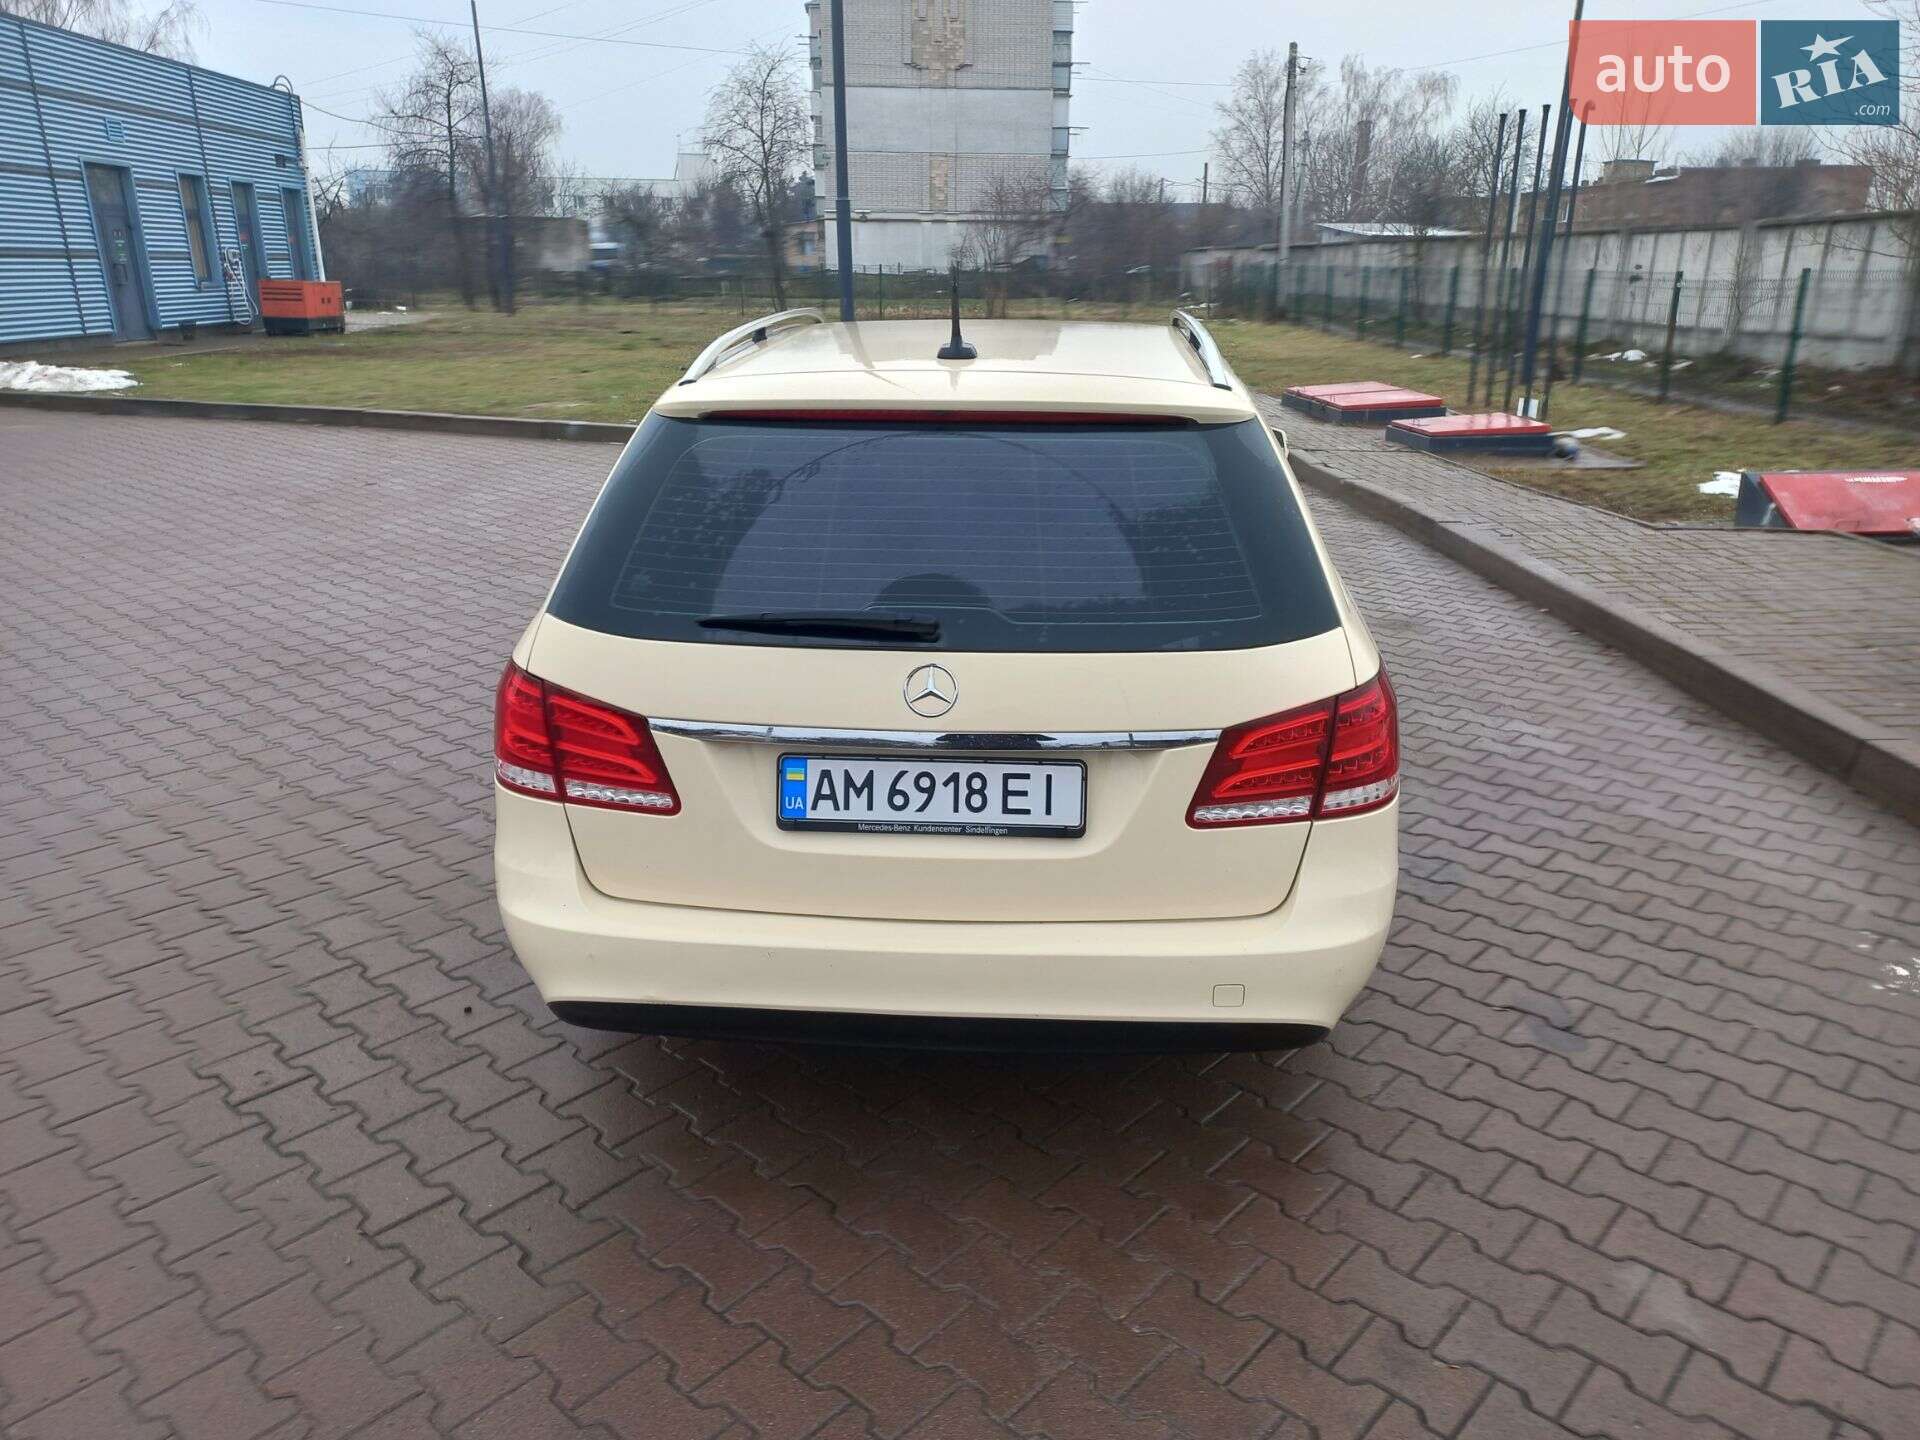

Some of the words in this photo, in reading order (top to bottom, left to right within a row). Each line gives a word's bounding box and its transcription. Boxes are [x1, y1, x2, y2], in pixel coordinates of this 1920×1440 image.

[811, 769, 874, 811] AM
[887, 770, 988, 814] 6918
[1002, 773, 1053, 816] EI
[785, 797, 805, 810] UA
[857, 823, 911, 833] Mercedes-Benz
[913, 824, 962, 833] Kundencenter
[965, 825, 1008, 835] Sindelfingen
